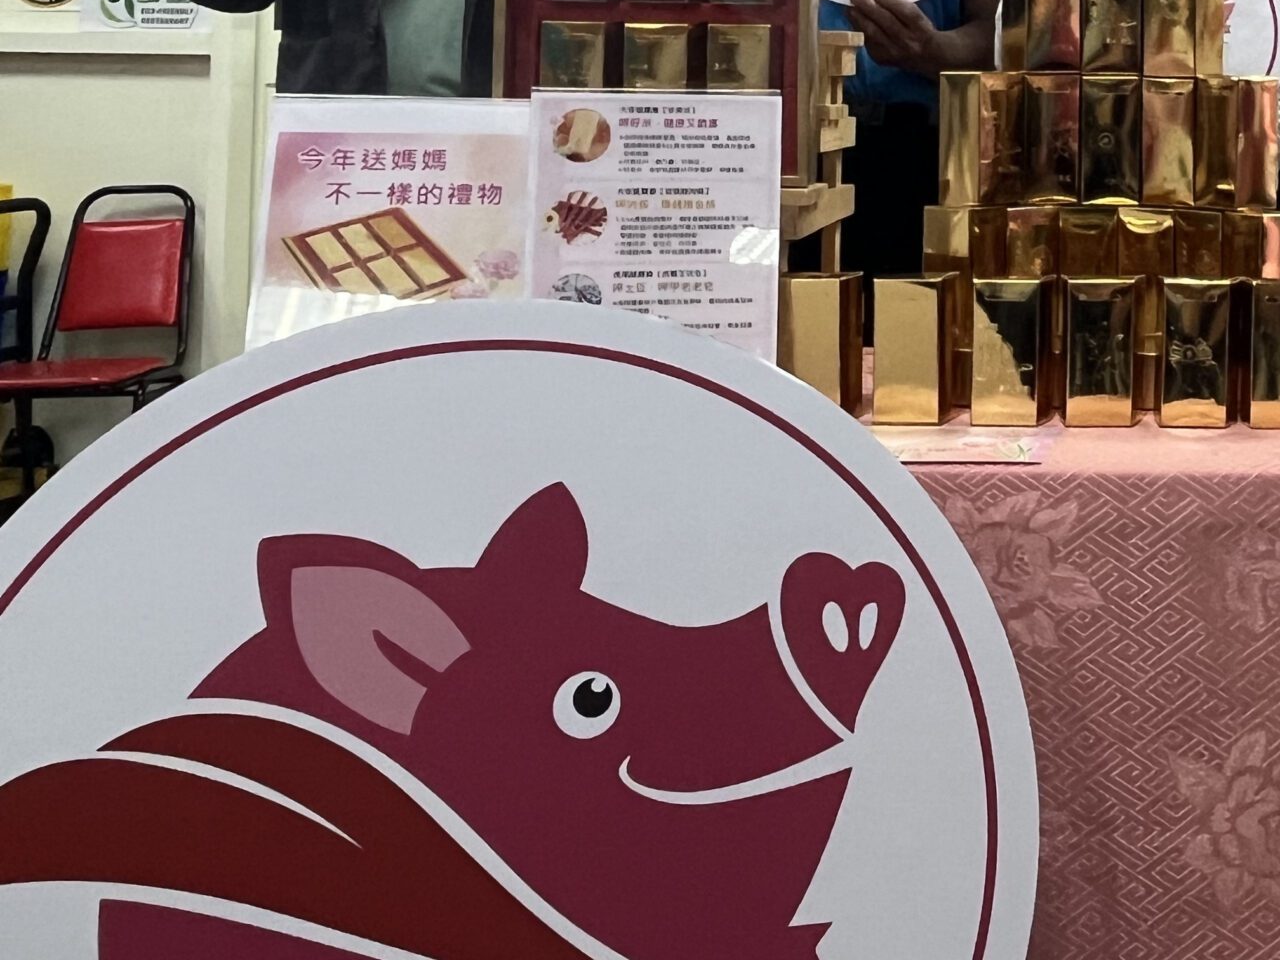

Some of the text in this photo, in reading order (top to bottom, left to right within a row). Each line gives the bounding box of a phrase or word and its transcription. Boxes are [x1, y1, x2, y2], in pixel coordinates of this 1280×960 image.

[299, 146, 448, 172] 今年送媽媽
[324, 182, 503, 206] 不一樣的禮物
